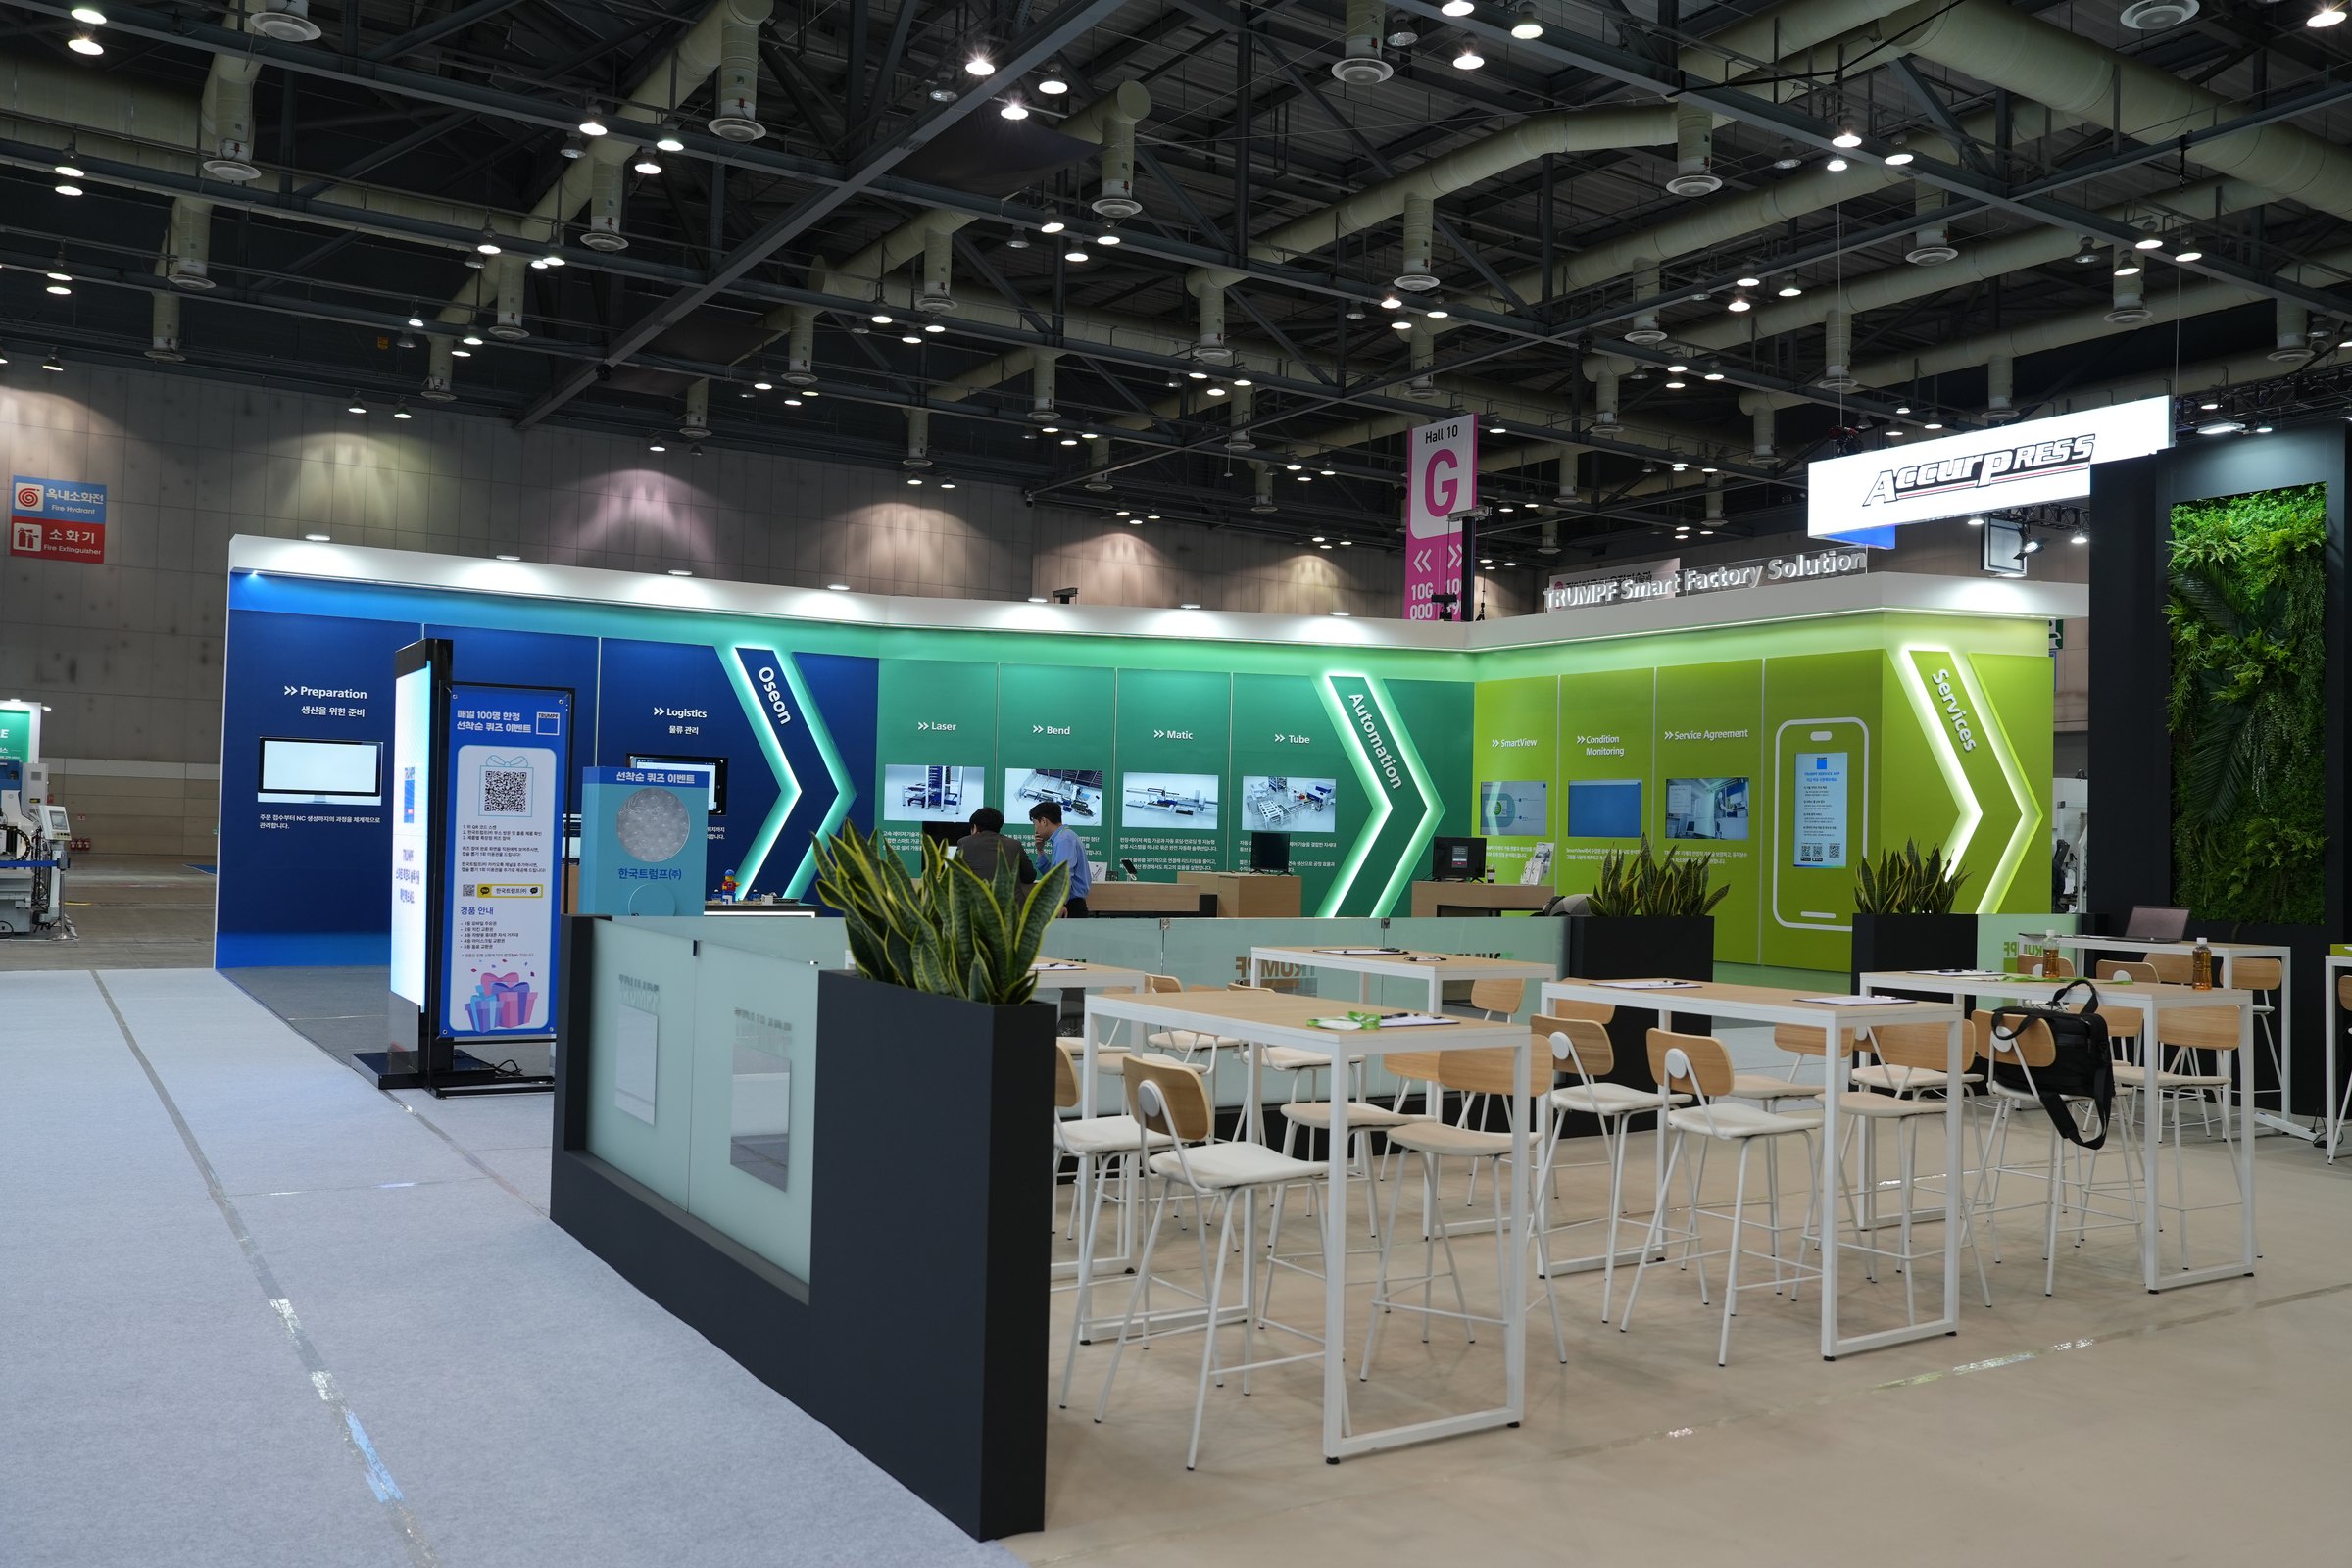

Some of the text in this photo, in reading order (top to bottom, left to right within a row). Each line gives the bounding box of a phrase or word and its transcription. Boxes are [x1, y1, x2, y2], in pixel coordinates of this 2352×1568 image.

[1425, 424, 1458, 444] Hall 10
[1424, 449, 1458, 518] G
[46, 488, 104, 505] 옥내소화전
[67, 506, 95, 514] Hydrant
[59, 546, 102, 555] Extinguisher
[1544, 581, 1618, 608] TRUMPF
[1620, 573, 1681, 600] Smart
[1684, 565, 1763, 591] Factory
[1767, 551, 1867, 580] Solution
[1411, 582, 1434, 601] 10G
[1446, 578, 1462, 595] 10
[300, 686, 368, 700] Preparation
[759, 666, 791, 725] Oseon
[301, 706, 365, 718] 생산을 위한 준비
[457, 710, 520, 722] 매일 100명 한정
[667, 708, 708, 719] Logistics
[1932, 668, 1976, 752] Services
[457, 721, 531, 733] 선착순 퀴즈 이벤트
[669, 725, 699, 735] 물류 관리
[931, 722, 956, 731] Laser
[1047, 726, 1070, 735] Bend
[1166, 730, 1193, 741] Matic
[1289, 735, 1310, 745] Tube
[1586, 735, 1620, 745] Condition
[1674, 729, 1748, 741] Service Agreement
[1348, 694, 1402, 789] Automation
[1500, 738, 1538, 748] SmartView
[1586, 747, 1625, 758] Monitoring
[616, 771, 695, 784] 선착순 퀴즈 이벤트
[618, 868, 682, 881] 한국트럼프(주)
[461, 906, 494, 915] 경품 안내
